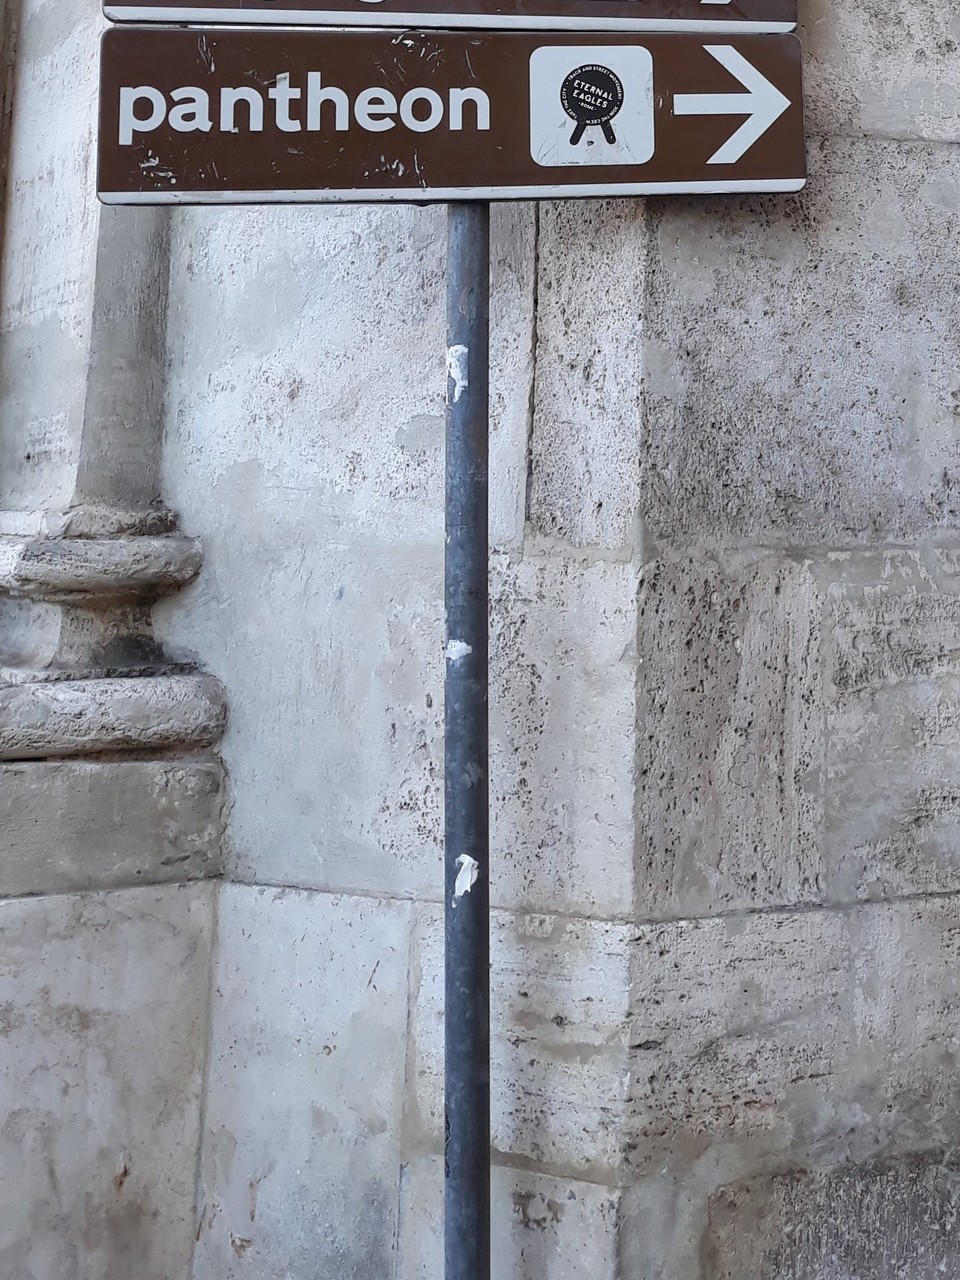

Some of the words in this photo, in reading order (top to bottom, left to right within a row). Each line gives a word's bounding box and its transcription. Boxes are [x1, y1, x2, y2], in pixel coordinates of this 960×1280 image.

[573, 80, 613, 100] ETERNAL
[573, 90, 608, 108] EAGLES
[118, 71, 491, 146] pantheon
